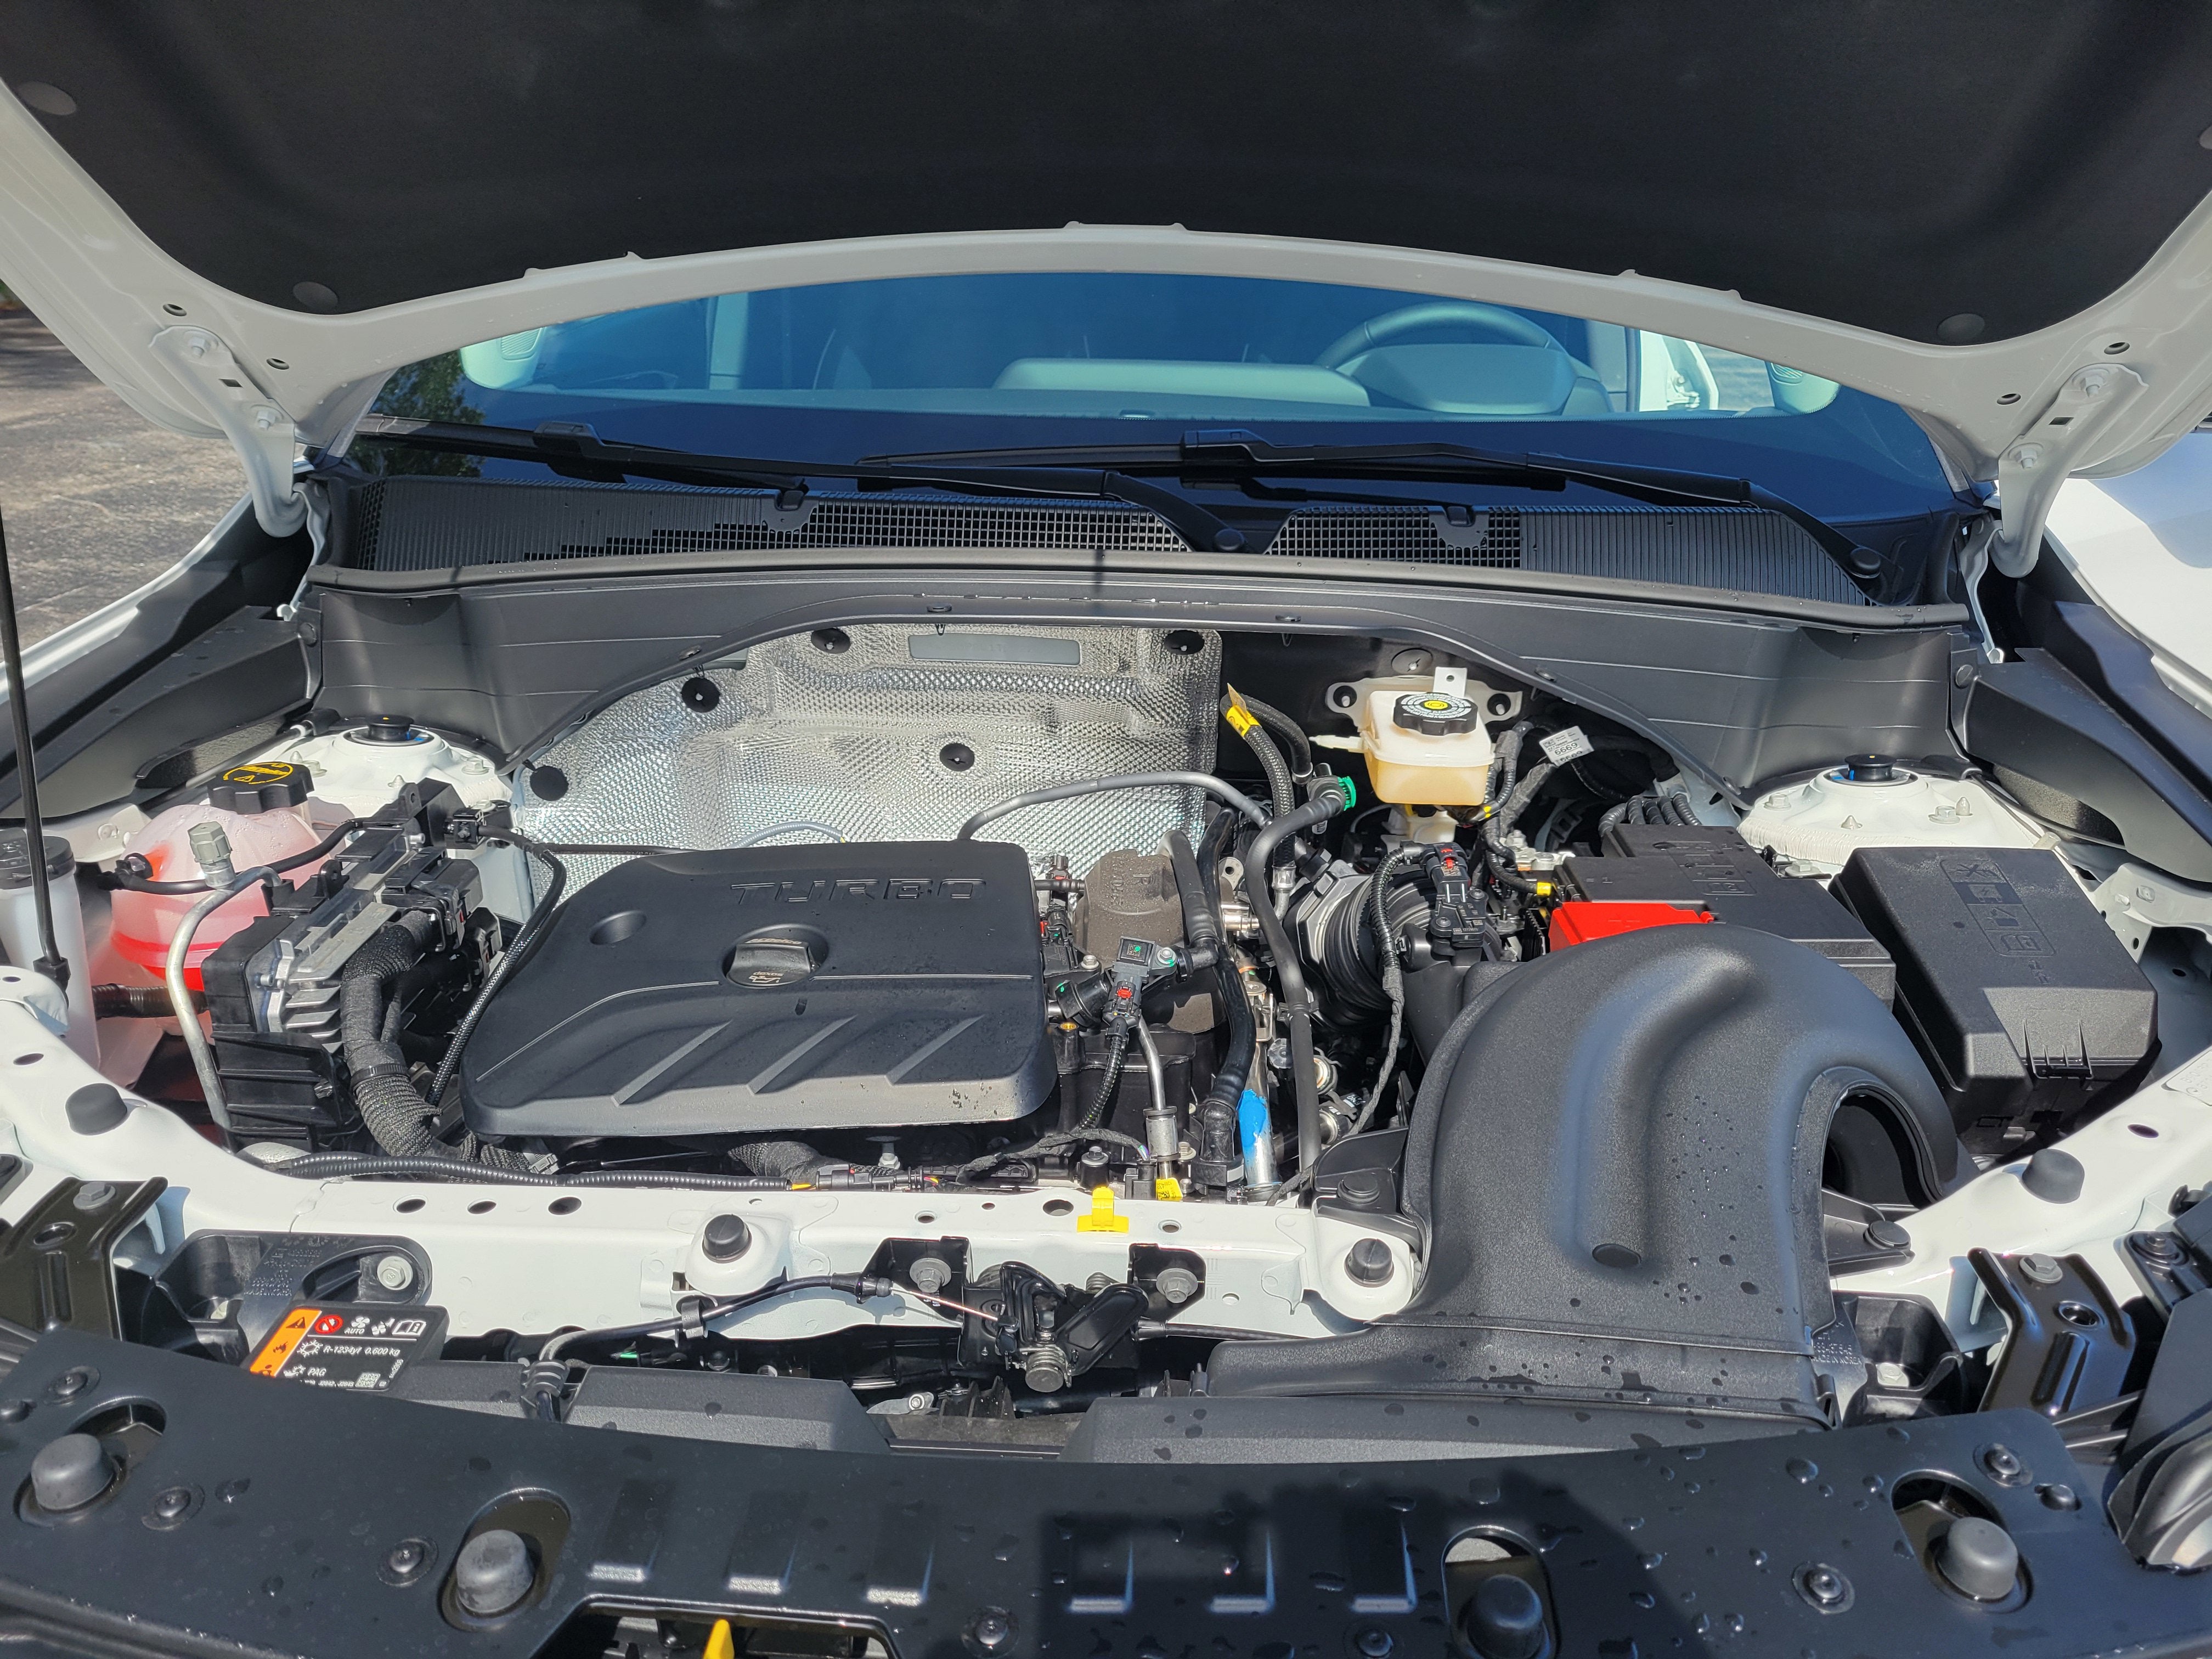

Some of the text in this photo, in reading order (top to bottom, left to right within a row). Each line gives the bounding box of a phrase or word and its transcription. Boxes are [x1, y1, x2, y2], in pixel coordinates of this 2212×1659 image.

[1555, 742, 1578, 755] 6669
[731, 878, 986, 905] TURBO
[323, 1345, 361, 1356] R-1234yf
[308, 1368, 326, 1376] PAG
